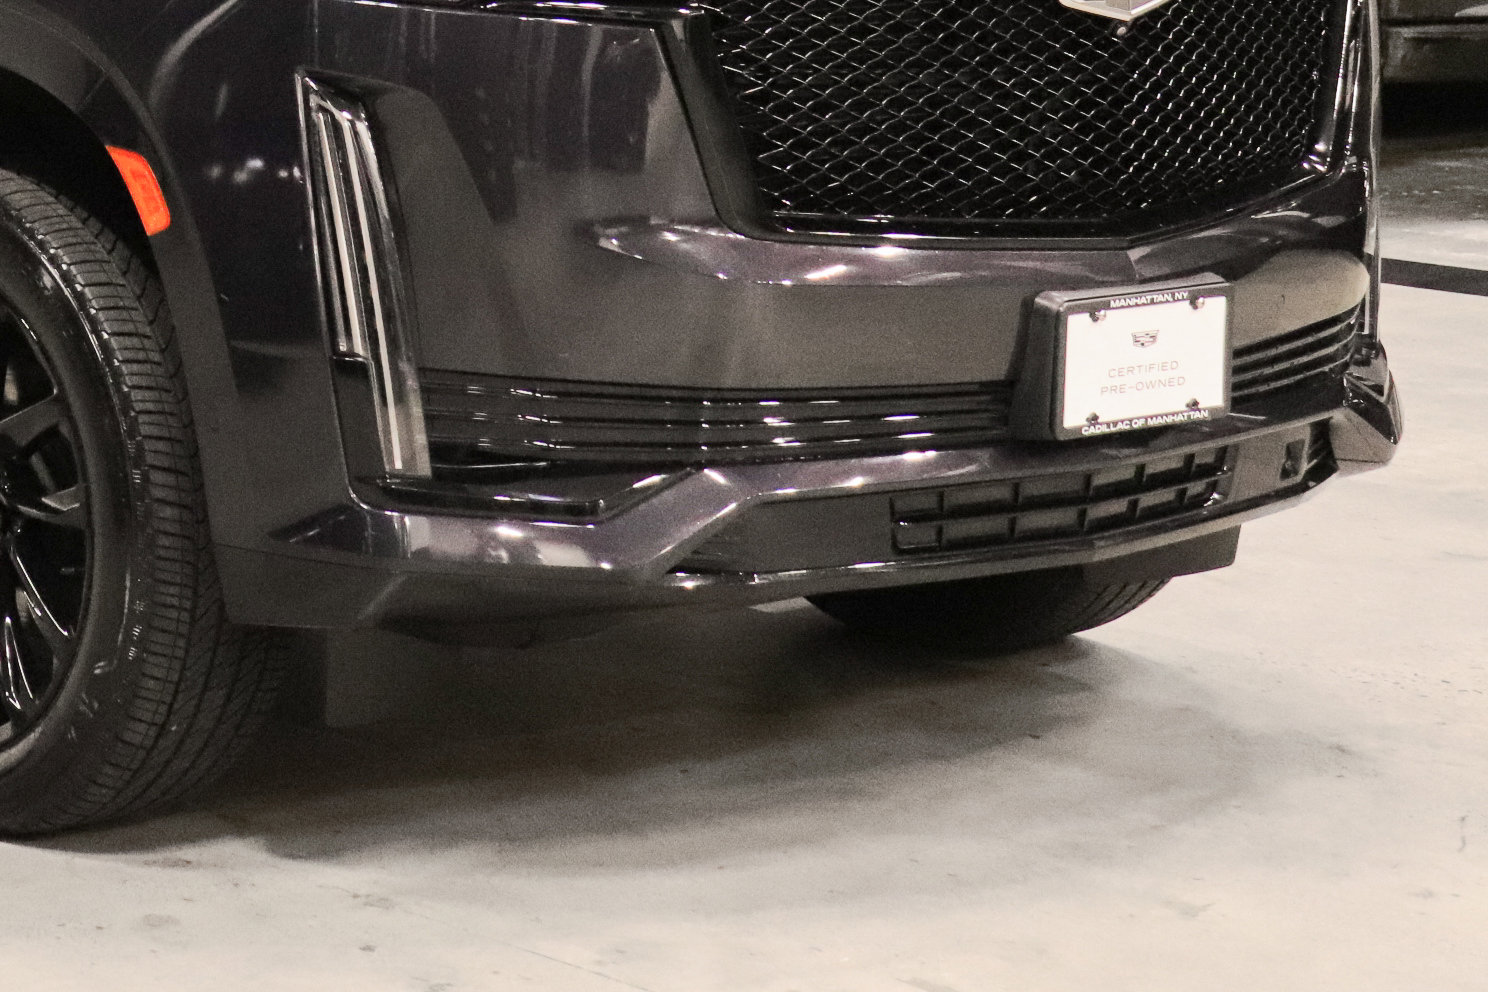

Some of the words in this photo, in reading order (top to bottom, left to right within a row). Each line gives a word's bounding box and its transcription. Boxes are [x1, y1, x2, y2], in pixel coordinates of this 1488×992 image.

[1110, 293, 1173, 308] MANHATTAN,
[1174, 291, 1189, 300] NY
[1108, 360, 1179, 378] CERTIFIED
[1100, 376, 1186, 396] PRE-OWNED
[1081, 420, 1130, 435] CADILLAC
[1131, 418, 1146, 428] OF
[1147, 410, 1209, 426] MANHATTAN
